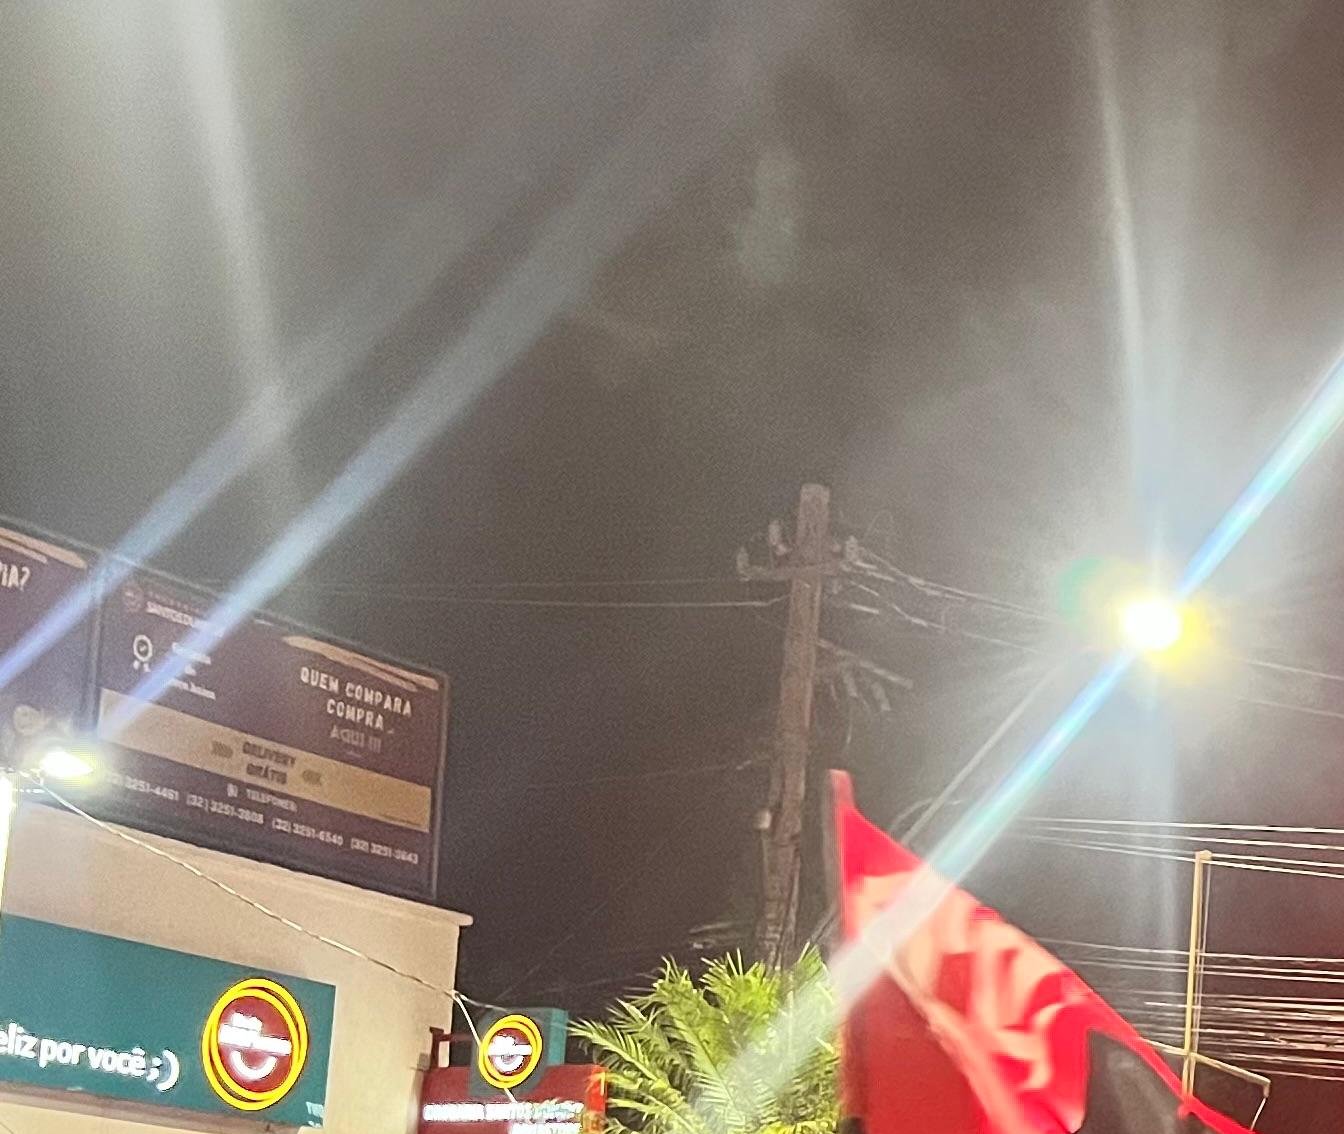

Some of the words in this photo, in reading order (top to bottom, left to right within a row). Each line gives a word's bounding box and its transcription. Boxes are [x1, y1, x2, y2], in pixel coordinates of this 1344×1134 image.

[300, 666, 340, 695] QUEM
[345, 682, 413, 717] COMPARA
[326, 698, 385, 731] COMPRA
[330, 725, 366, 748] AQUI
[39, 1037, 87, 1069] por
[87, 1045, 146, 1078] você
